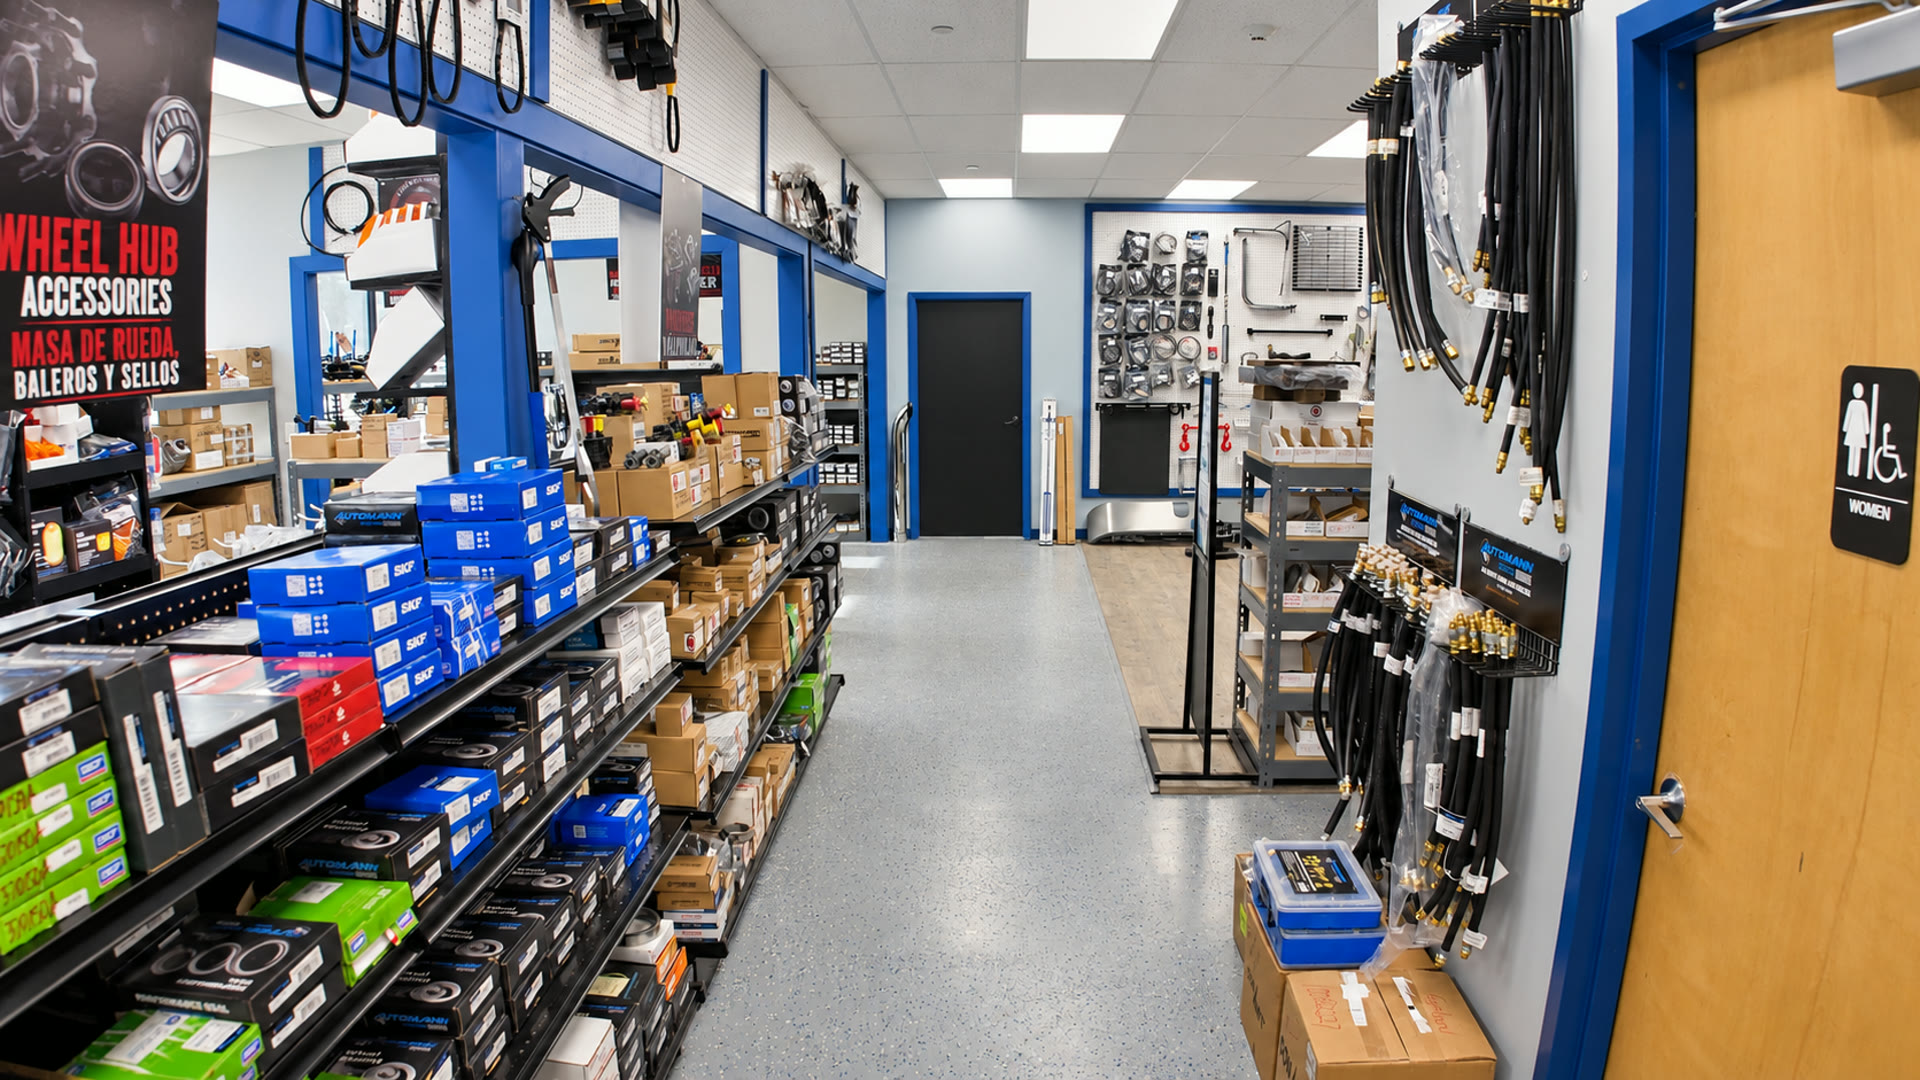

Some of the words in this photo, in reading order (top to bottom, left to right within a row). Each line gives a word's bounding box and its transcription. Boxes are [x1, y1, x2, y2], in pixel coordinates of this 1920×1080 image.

[0, 213, 109, 274] WHEEL
[119, 222, 179, 276] HUB
[20, 275, 172, 317] ACCESSORIES
[11, 329, 75, 368] MASA
[80, 328, 107, 363] DE
[113, 326, 179, 361] RUEDA,
[14, 365, 98, 400] BALEROS
[103, 364, 115, 391] Y
[121, 360, 180, 389] SELLOS
[334, 512, 403, 521] AUTOMANN
[1849, 498, 1892, 521] WOMEN
[394, 560, 416, 577] SKF
[1481, 541, 1535, 574] AUTOMANN
[401, 596, 423, 615] SKF
[406, 632, 428, 651] SKF
[414, 665, 435, 686] SKF
[472, 788, 492, 807] SKF
